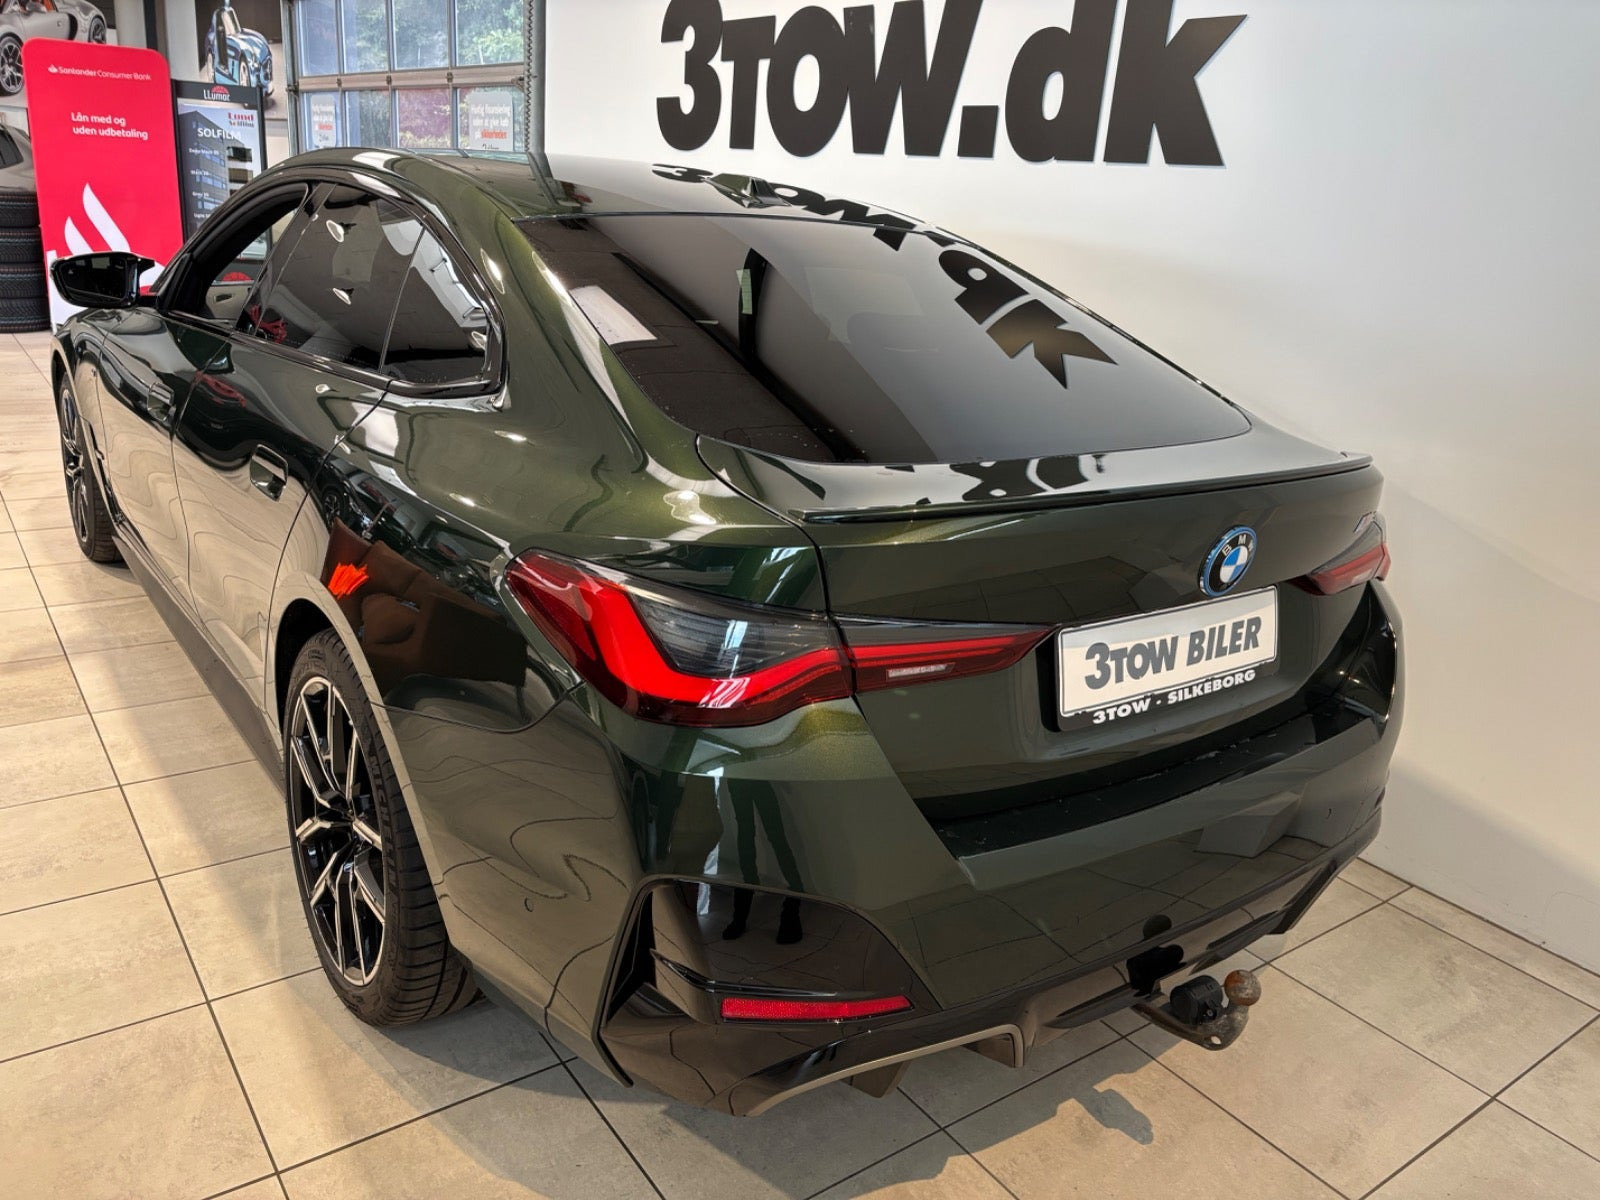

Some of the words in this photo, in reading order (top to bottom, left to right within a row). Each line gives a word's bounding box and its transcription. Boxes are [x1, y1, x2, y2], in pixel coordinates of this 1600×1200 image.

[58, 66, 97, 76] Santander
[97, 70, 133, 80] Consumer
[133, 73, 152, 81] Bank
[656, 0, 1247, 166] 3TOW.dk
[71, 112, 89, 122] Lån
[90, 115, 112, 124] med
[113, 117, 126, 127] og
[73, 126, 97, 135] uden
[98, 128, 149, 141] udbetaling
[197, 127, 242, 140] SOLFILM
[1221, 534, 1254, 556] BMW
[1085, 636, 1179, 690] 3TOW
[1186, 616, 1262, 667] BILER
[1092, 698, 1150, 725] 3TOW
[1167, 669, 1256, 706] SILKEBORG
[368, 754, 398, 888] MICHELIN
